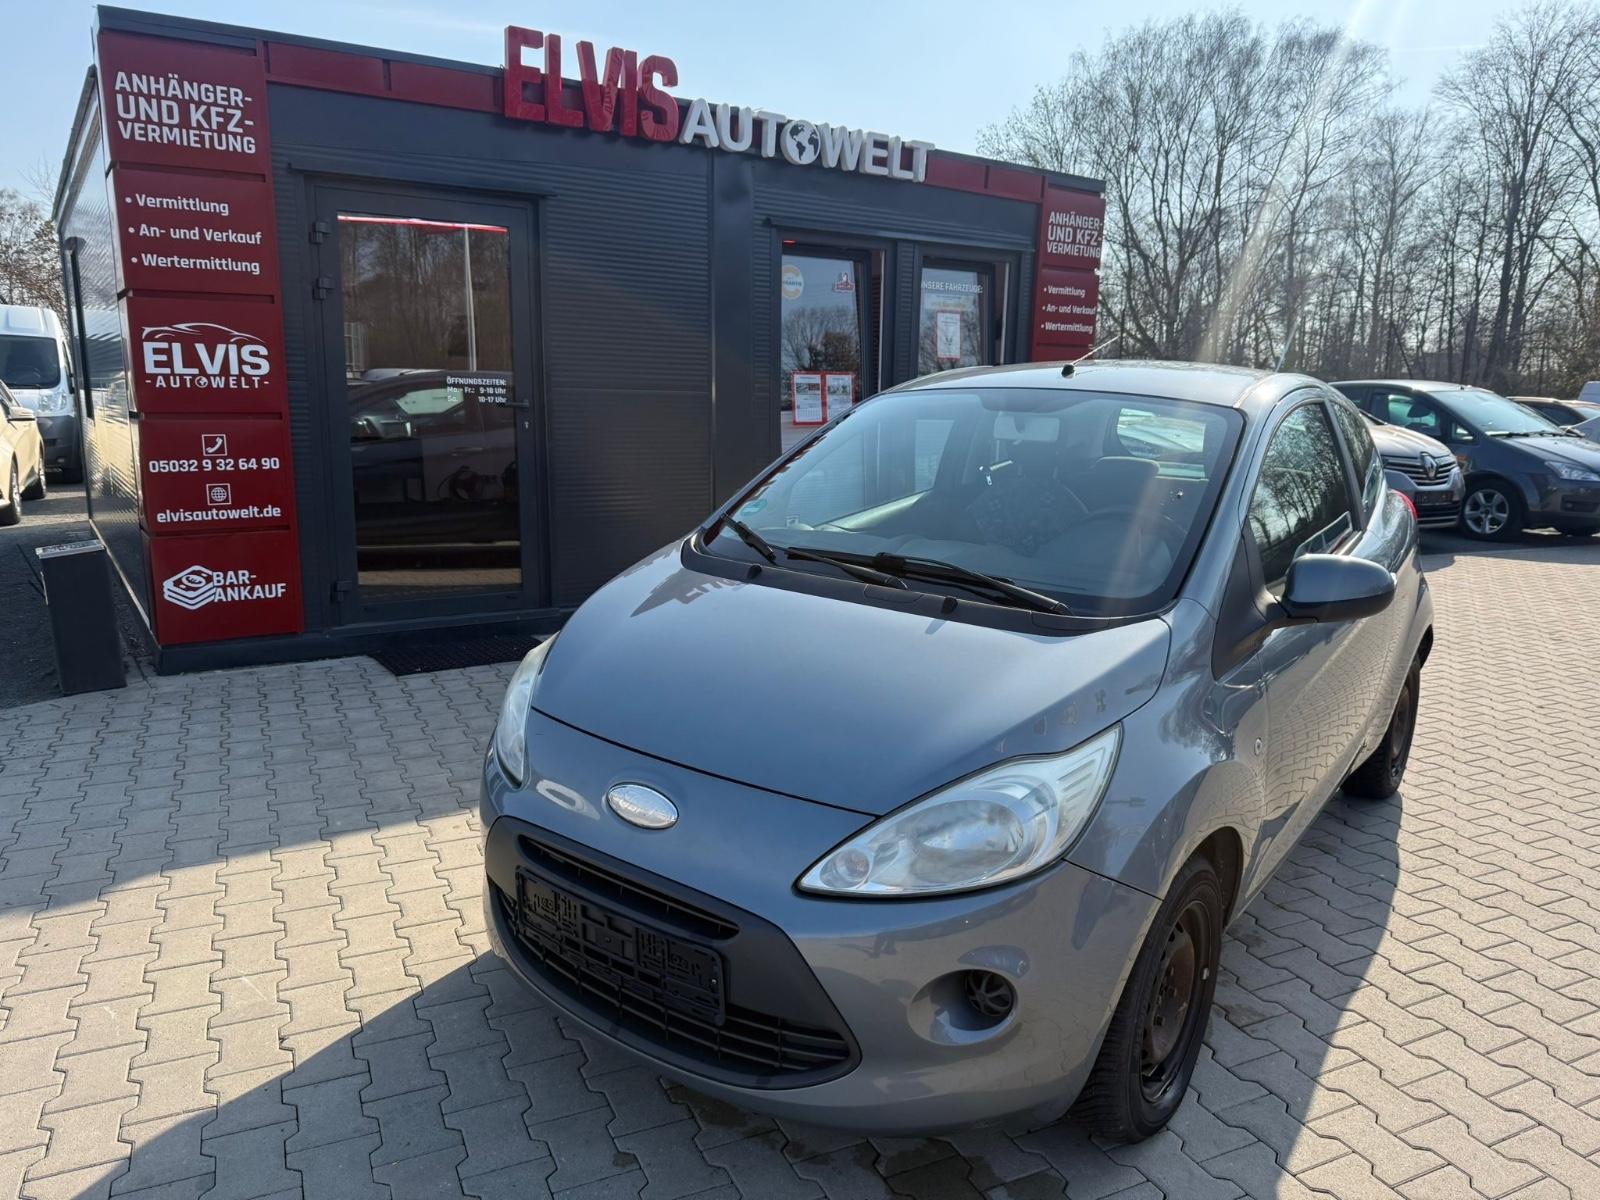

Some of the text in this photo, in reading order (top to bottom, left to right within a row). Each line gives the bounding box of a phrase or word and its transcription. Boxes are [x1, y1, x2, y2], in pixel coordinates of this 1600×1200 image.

[115, 71, 252, 107] ANHÄNGER-
[504, 25, 679, 142] ELVIS
[116, 93, 254, 133] UND KFZ-
[118, 121, 256, 154] VERMIETUNG
[135, 193, 229, 216] Vermittlung
[1048, 211, 1103, 229] ANHÄNGER-
[139, 223, 262, 244] An- und Verkauf
[1048, 225, 1073, 243] UND
[1047, 241, 1101, 258] VERMIETUNG
[141, 253, 260, 275] Wertermittlung
[921, 280, 945, 290] NSERE
[1048, 285, 1086, 298] Vermittlung
[1046, 304, 1096, 315] An- und Verkauf
[1045, 322, 1093, 334] Wertermittlung
[142, 342, 270, 376] ELVIS
[478, 395, 494, 403] 10-17
[479, 386, 494, 394] 9-18
[149, 457, 280, 473] 05032 9 32 64 90
[157, 505, 281, 523] elvisautowelt.de
[213, 570, 257, 586] BAR-
[214, 583, 286, 602] ANKAUF
